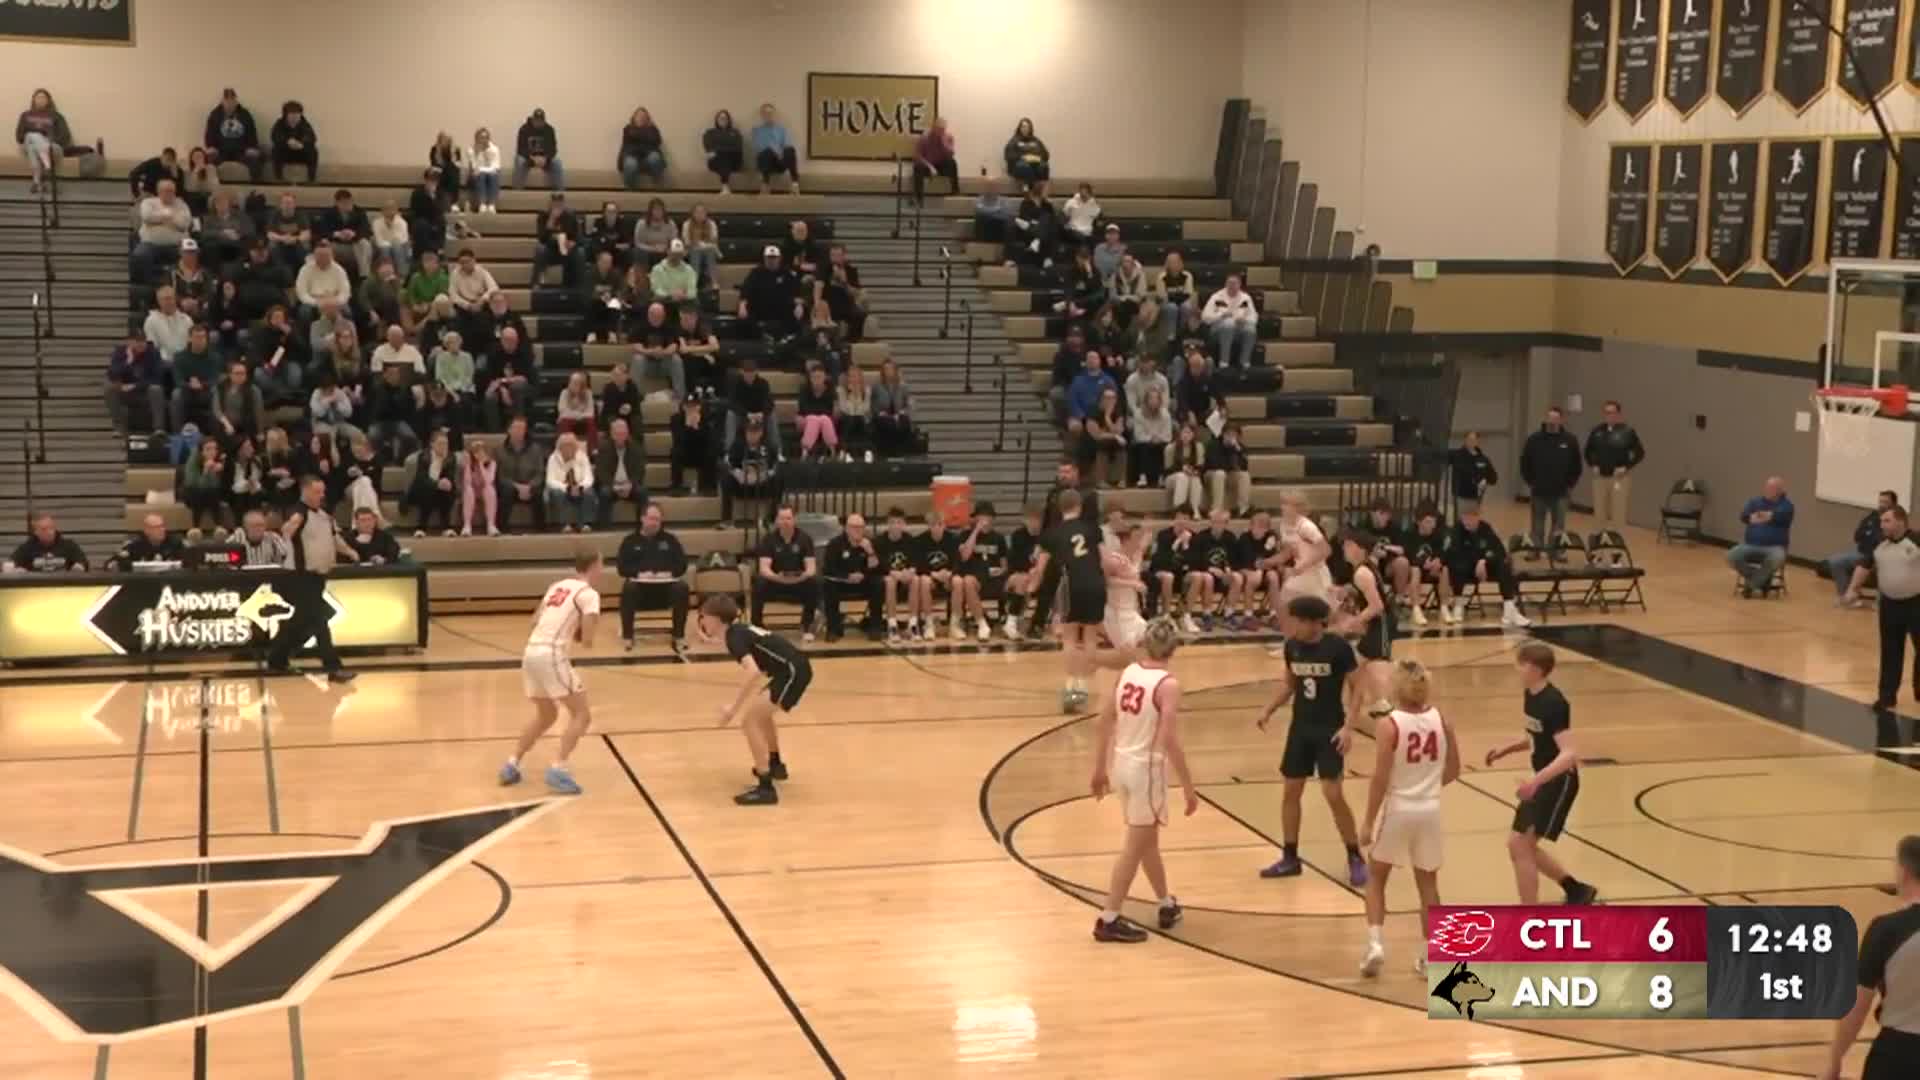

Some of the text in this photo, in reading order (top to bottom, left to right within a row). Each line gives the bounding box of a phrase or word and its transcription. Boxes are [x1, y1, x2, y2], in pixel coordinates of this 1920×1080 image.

[820, 99, 926, 135] HOME
[1070, 533, 1089, 558] 2
[157, 584, 242, 612] ANDOVER
[138, 609, 253, 646] HUSKIES
[1120, 682, 1146, 715] 23
[1303, 677, 1318, 700] 3
[1406, 730, 1439, 764] 24
